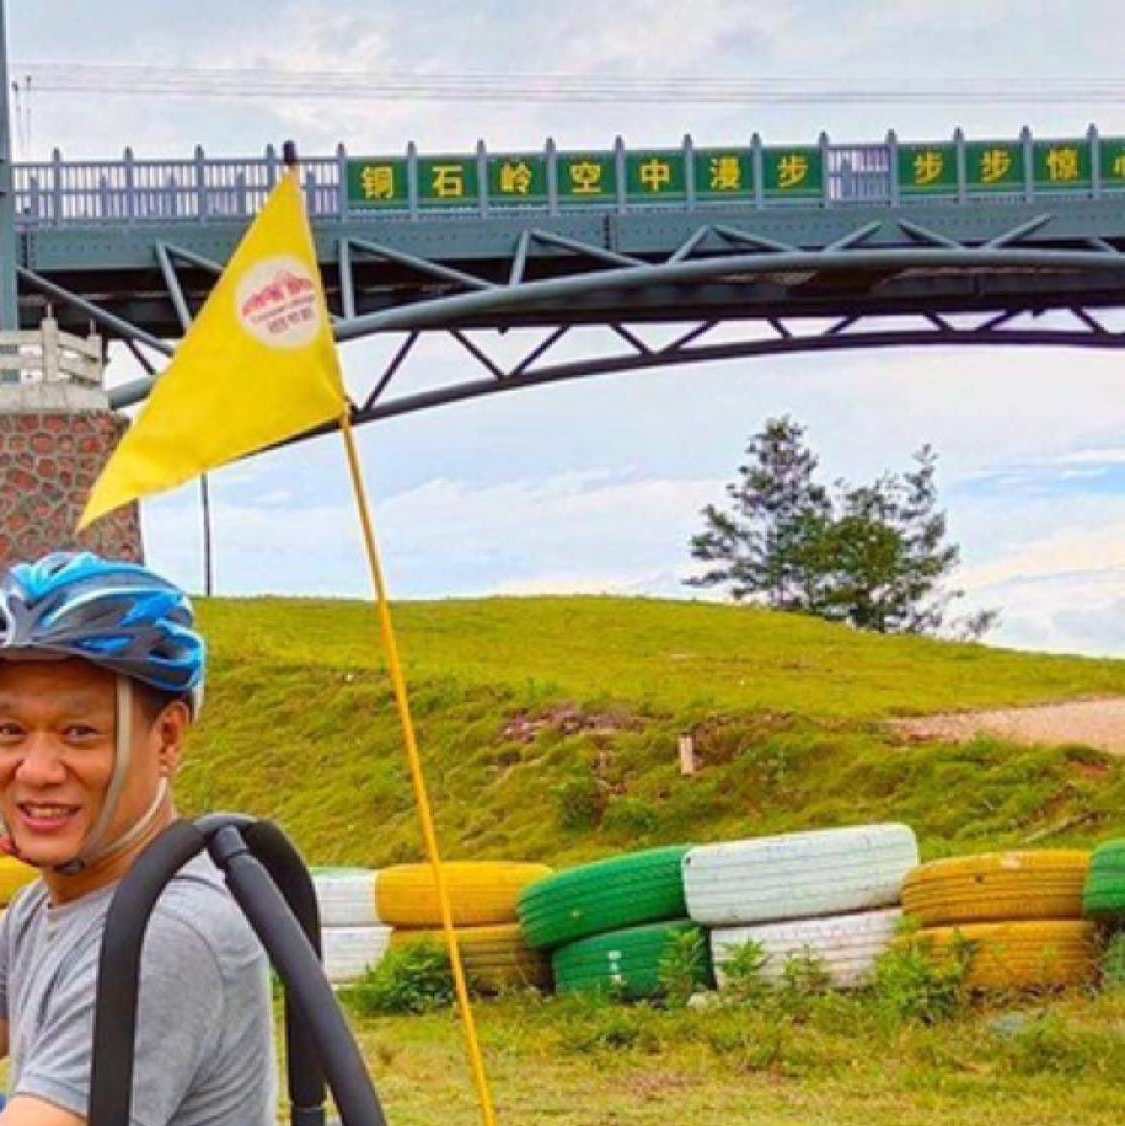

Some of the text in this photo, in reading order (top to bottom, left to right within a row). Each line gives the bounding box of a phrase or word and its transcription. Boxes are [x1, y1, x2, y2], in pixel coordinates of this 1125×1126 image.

[360, 154, 809, 199] 铜石岭空中漫步
